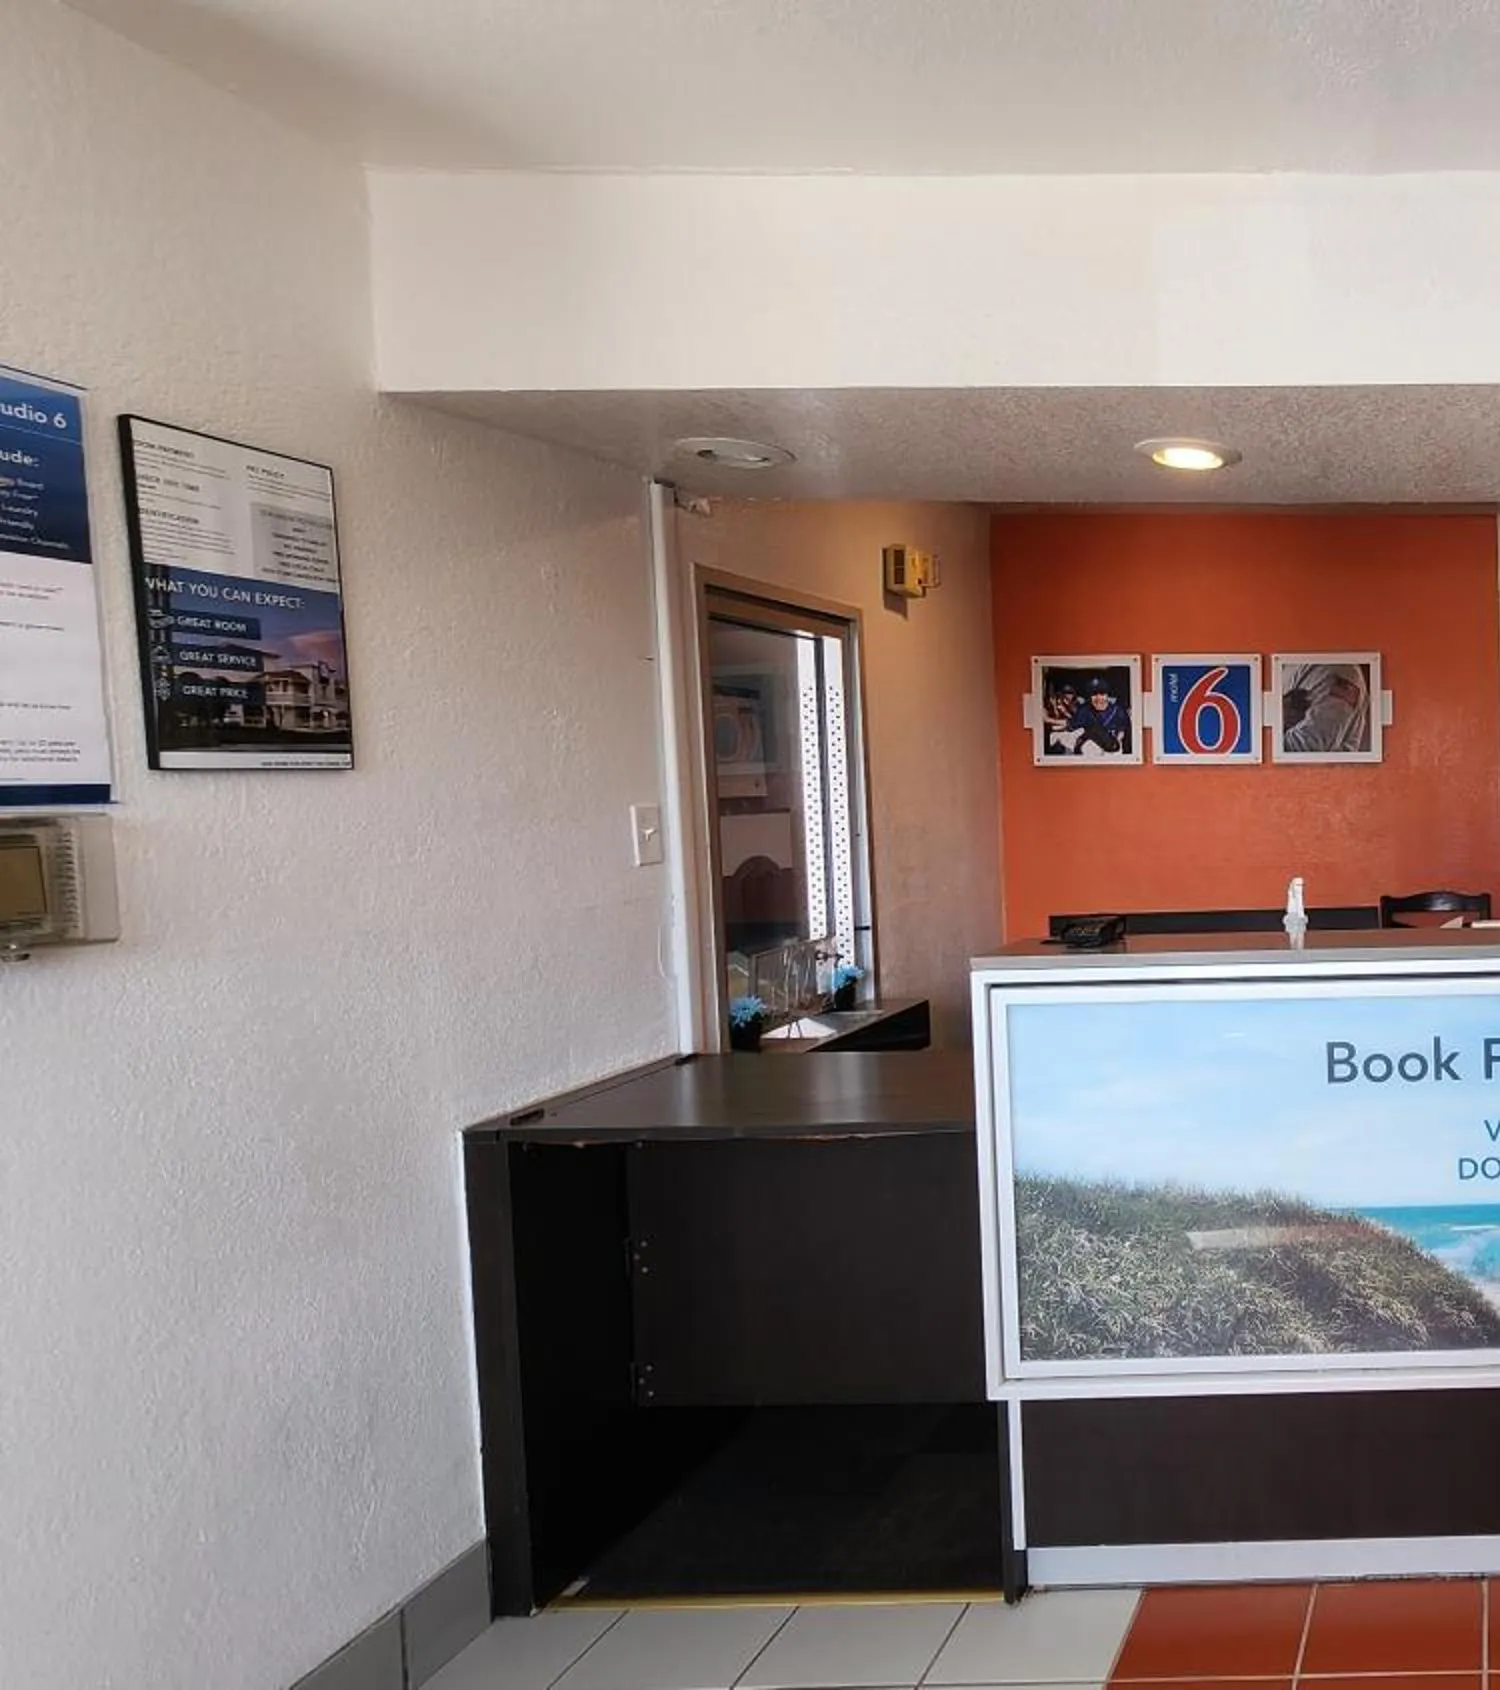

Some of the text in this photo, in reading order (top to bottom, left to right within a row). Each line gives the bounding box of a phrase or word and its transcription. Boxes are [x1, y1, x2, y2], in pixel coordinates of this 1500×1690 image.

[0, 402, 67, 429] udio 6
[0, 449, 40, 467] ude:
[189, 583, 218, 598] YOU
[222, 588, 251, 603] CAN
[255, 592, 305, 609] EXPECT:
[177, 615, 248, 632] GREAT ROOM
[180, 650, 257, 667] GREAT SERVICE
[183, 684, 249, 699] GREAT PRICE
[1178, 667, 1241, 755] 6
[1326, 1036, 1461, 1084] Book
